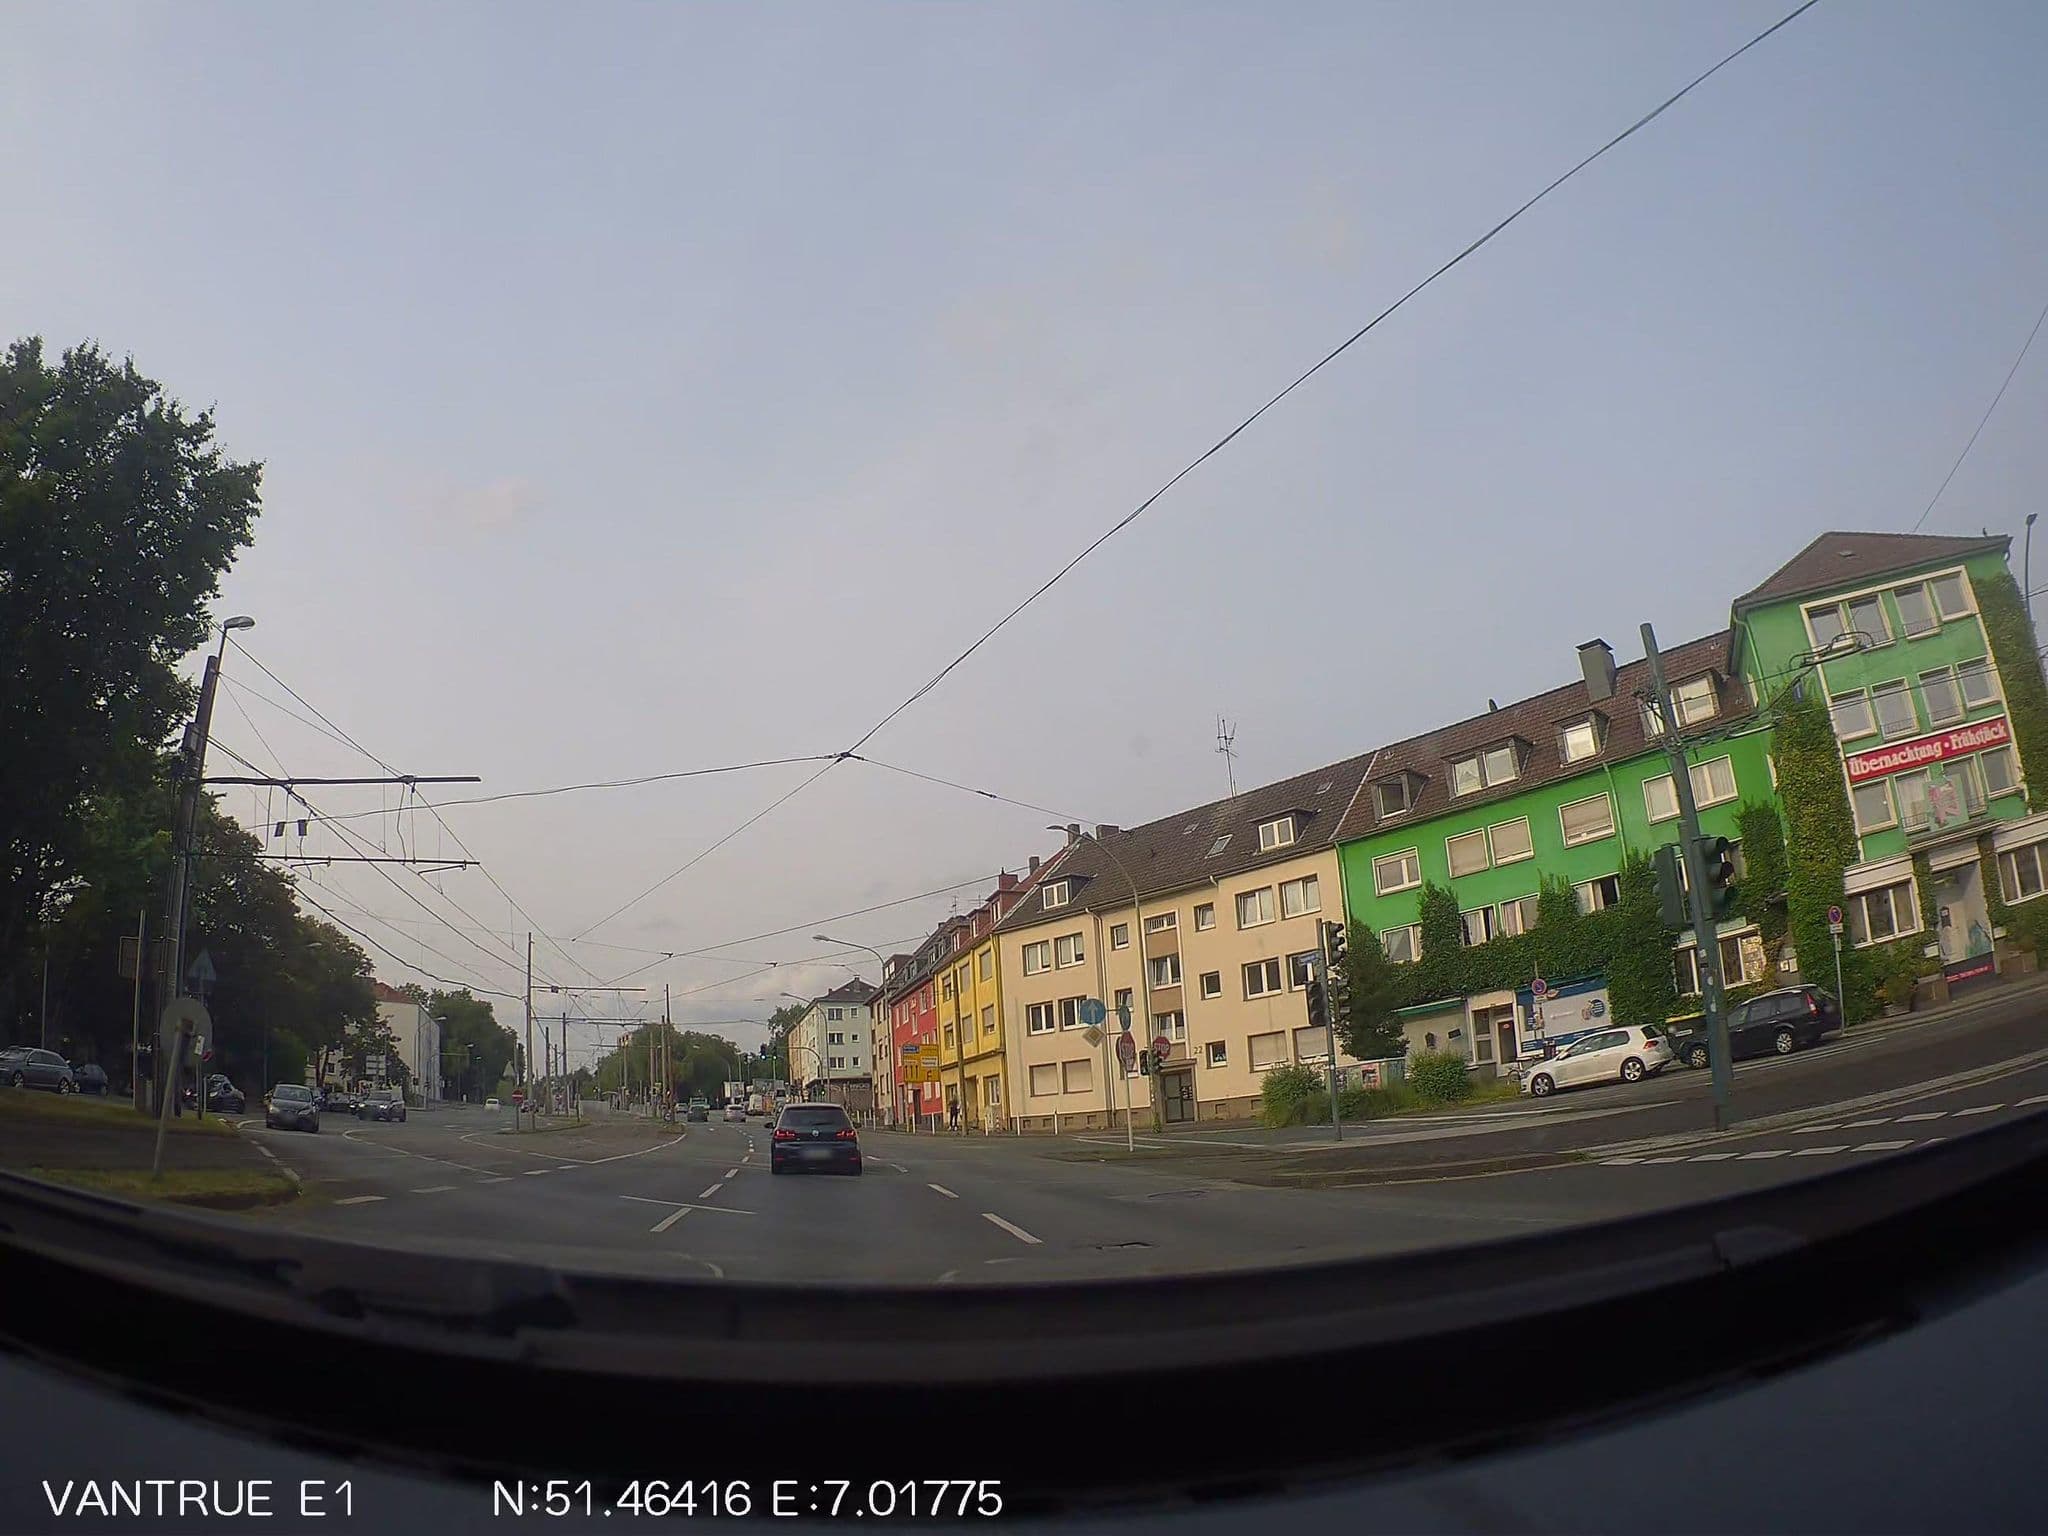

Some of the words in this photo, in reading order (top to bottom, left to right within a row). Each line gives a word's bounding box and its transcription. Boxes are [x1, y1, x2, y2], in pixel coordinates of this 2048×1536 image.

[1848, 740, 1942, 776] Übernachtung
[1950, 723, 2007, 750] Frühstück
[1193, 1045, 1203, 1055] 22
